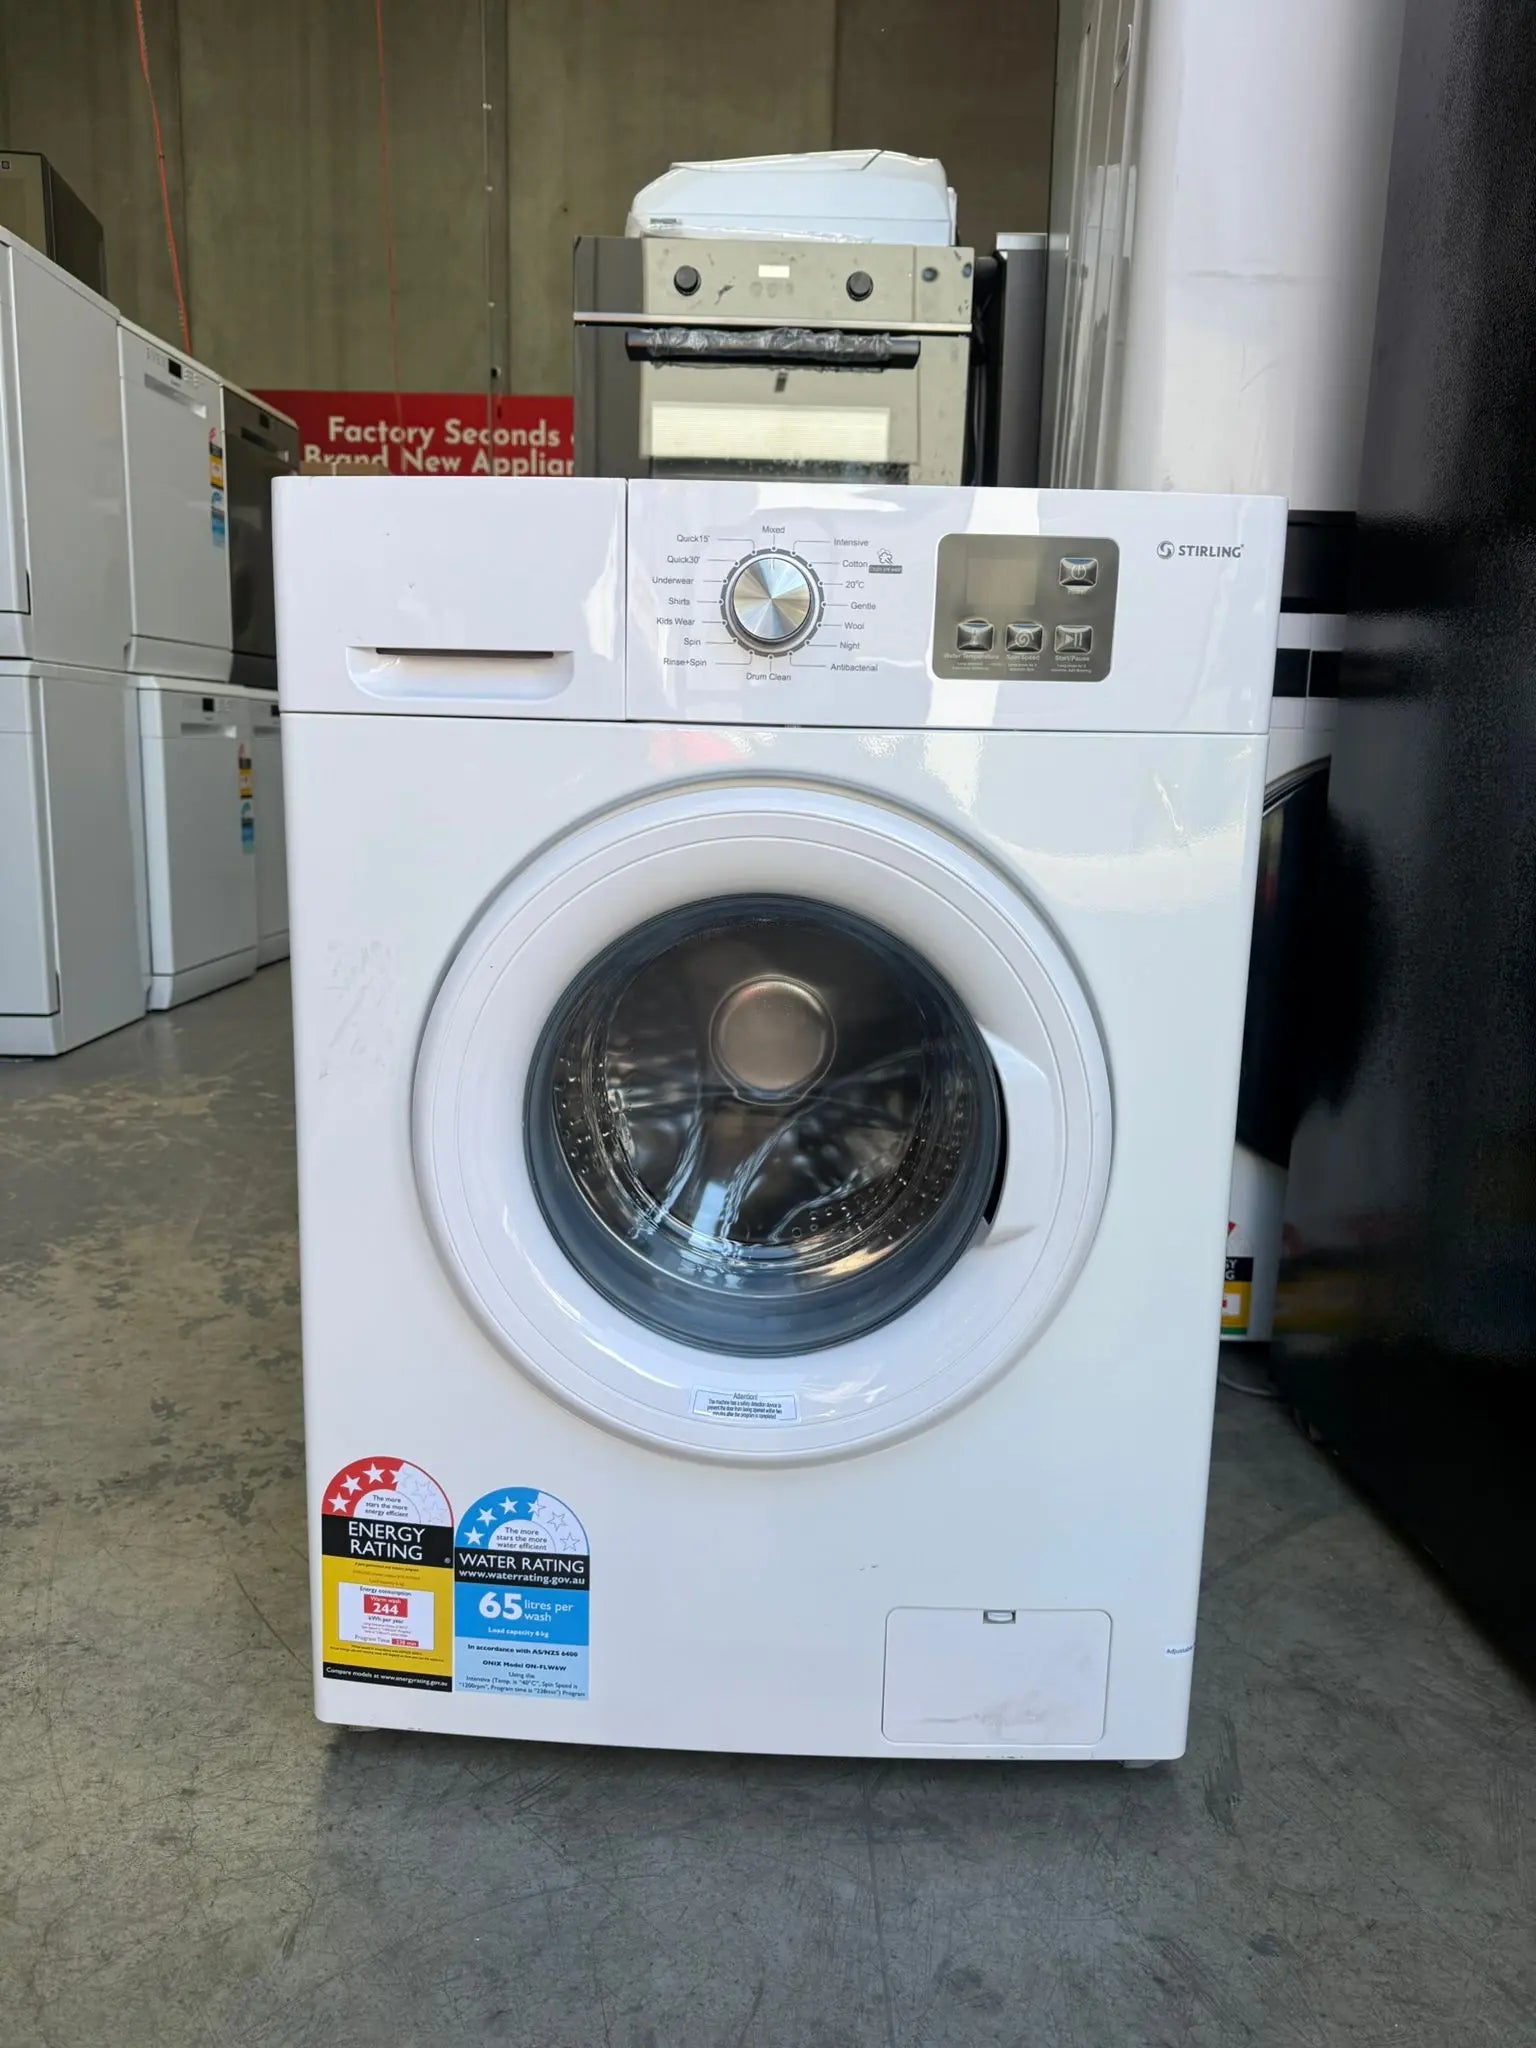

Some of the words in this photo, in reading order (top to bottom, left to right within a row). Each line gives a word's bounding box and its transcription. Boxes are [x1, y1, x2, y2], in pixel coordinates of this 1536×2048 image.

[328, 416, 435, 450] Factory
[444, 419, 560, 448] Seconds
[401, 447, 461, 473] New
[762, 526, 786, 535] Mixed
[834, 538, 869, 547] Intensive
[1178, 545, 1241, 558] STIRLING
[842, 559, 868, 568] Cotton
[652, 577, 694, 586] Underwear
[845, 580, 865, 589] 20°C
[668, 597, 690, 606] Shirts
[850, 601, 876, 610] Gentle
[656, 617, 675, 626] Kids
[677, 617, 695, 626] Wear
[844, 622, 864, 630] Wool
[684, 638, 701, 648] Spin
[839, 641, 860, 651] Night
[663, 658, 707, 668] Rinse+Spin
[830, 663, 878, 672] Antibacterial
[746, 672, 766, 681] Drum
[768, 673, 791, 682] Clean
[373, 1494, 384, 1502] The
[386, 1509, 408, 1517] efficient
[349, 1521, 425, 1543] ENERGY
[506, 1526, 519, 1535] The
[521, 1528, 539, 1536] more
[351, 1539, 423, 1561] RATING
[519, 1542, 547, 1551] efficient
[459, 1553, 516, 1570] WATER
[522, 1557, 585, 1574] RATING
[459, 1569, 585, 1586] www.waterrating.gov.au
[360, 1586, 377, 1594] Energy
[373, 1602, 399, 1615] 244
[479, 1591, 523, 1620] 65
[524, 1599, 552, 1611] litres
[555, 1604, 574, 1614] per
[525, 1612, 552, 1622] wash
[532, 1649, 560, 1657] AS/NZS
[326, 1667, 351, 1676] Compare
[352, 1671, 372, 1679] models
